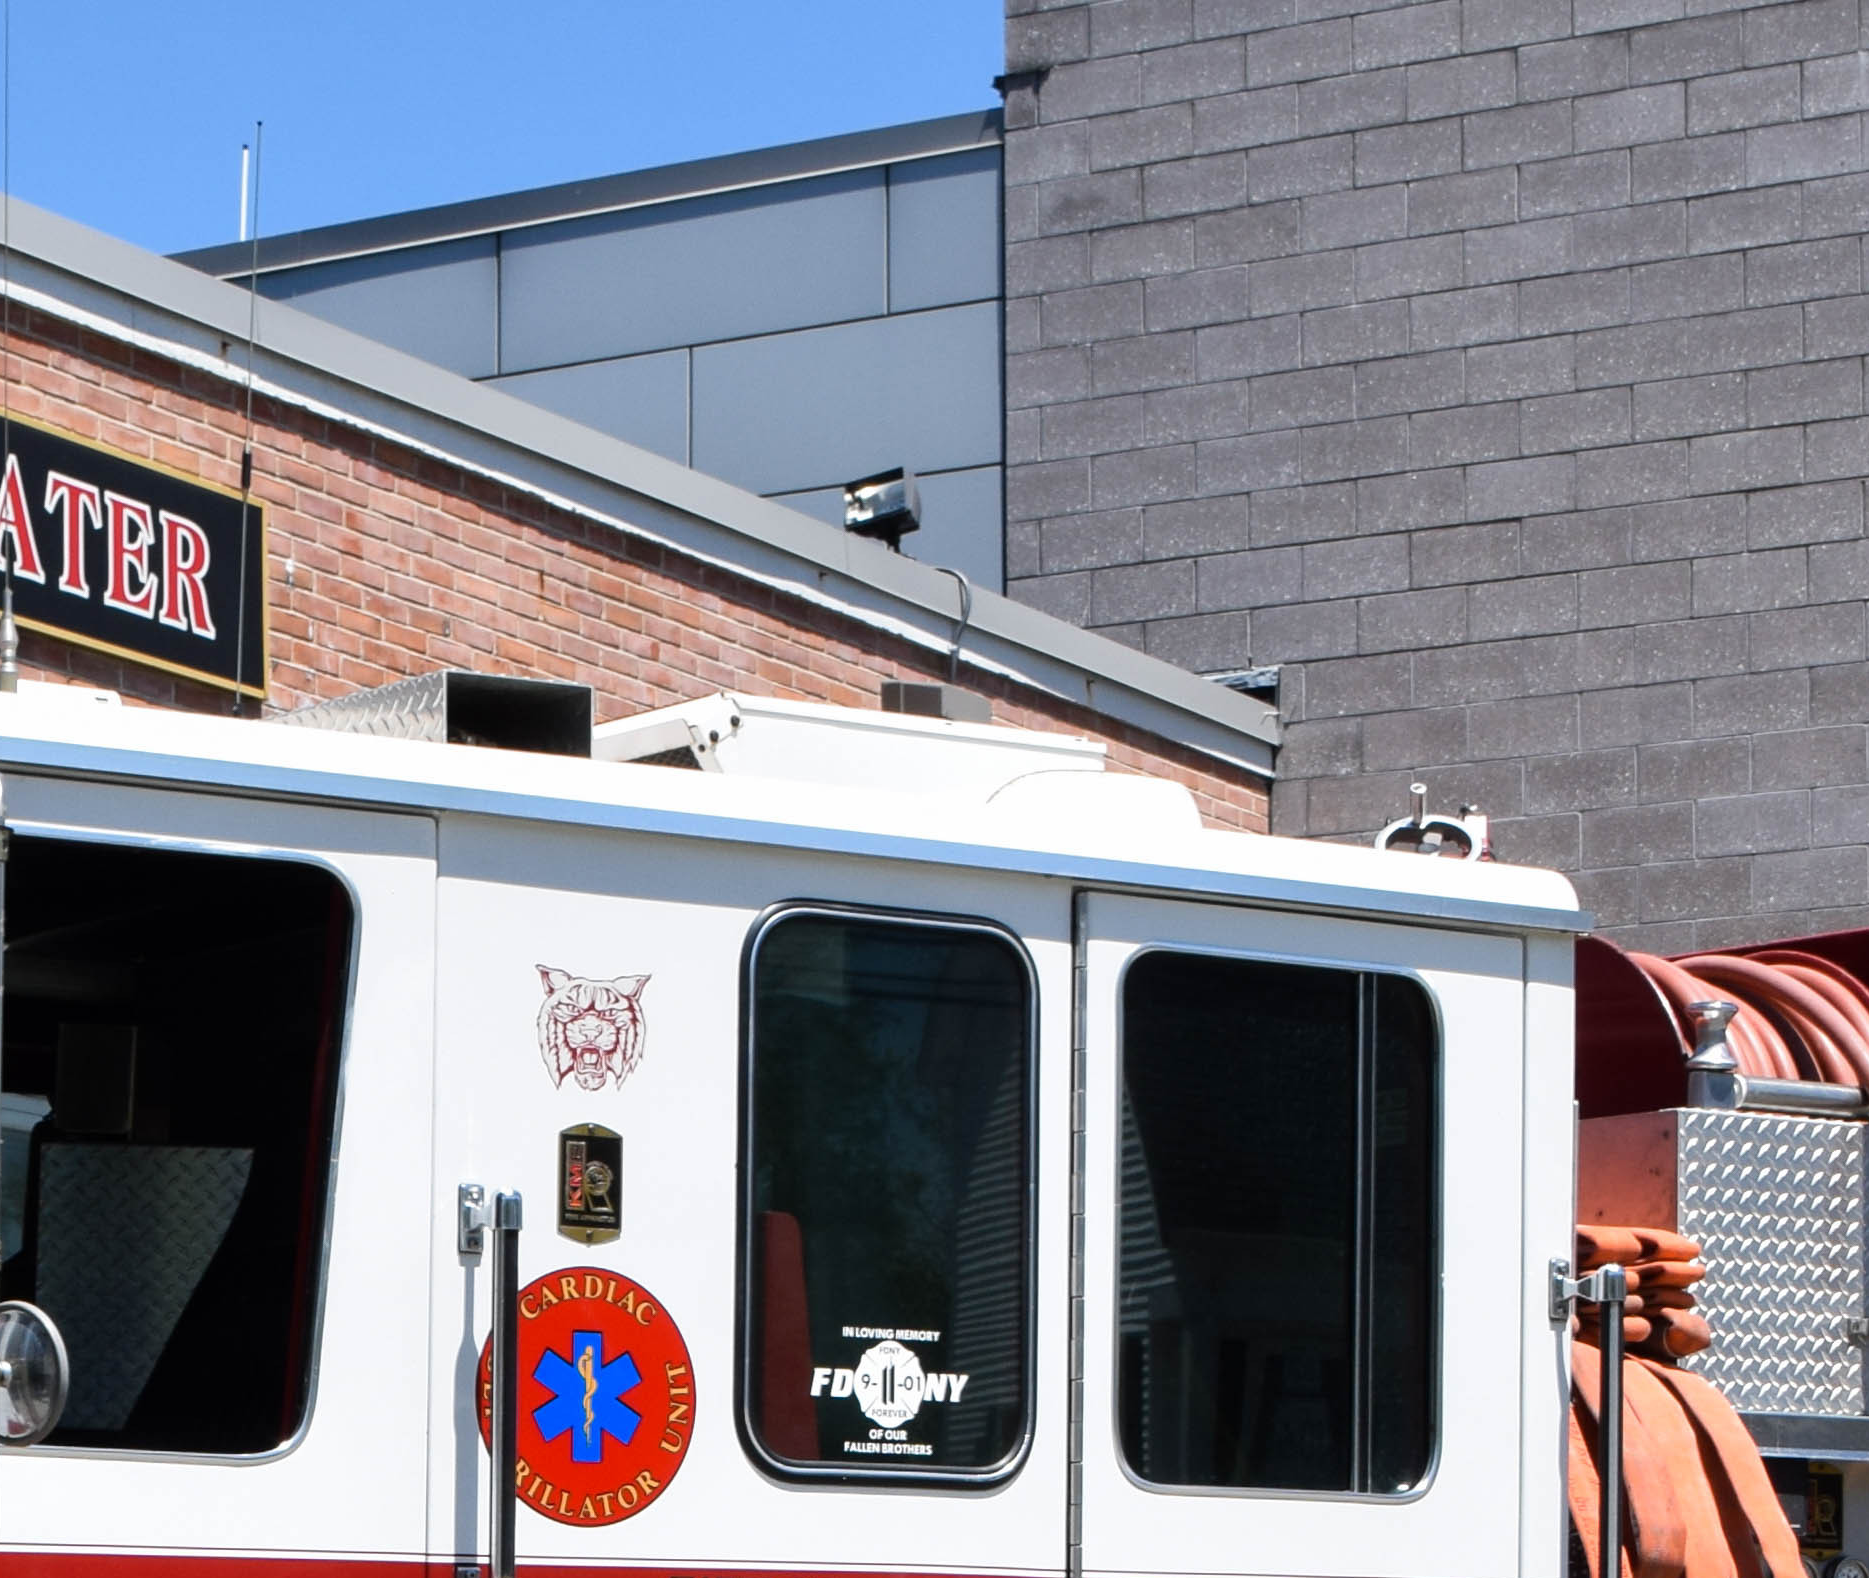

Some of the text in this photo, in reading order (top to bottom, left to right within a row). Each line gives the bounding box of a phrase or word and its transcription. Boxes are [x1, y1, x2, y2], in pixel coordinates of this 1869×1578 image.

[842, 1326, 941, 1342] IN LOVING MEMORY
[519, 1273, 658, 1326] CARDIAC
[659, 1362, 691, 1454] UNIT
[871, 1408, 908, 1418] FOREVER
[868, 1428, 908, 1441] OF OUR
[843, 1441, 933, 1456] FALLEN BROTHERS
